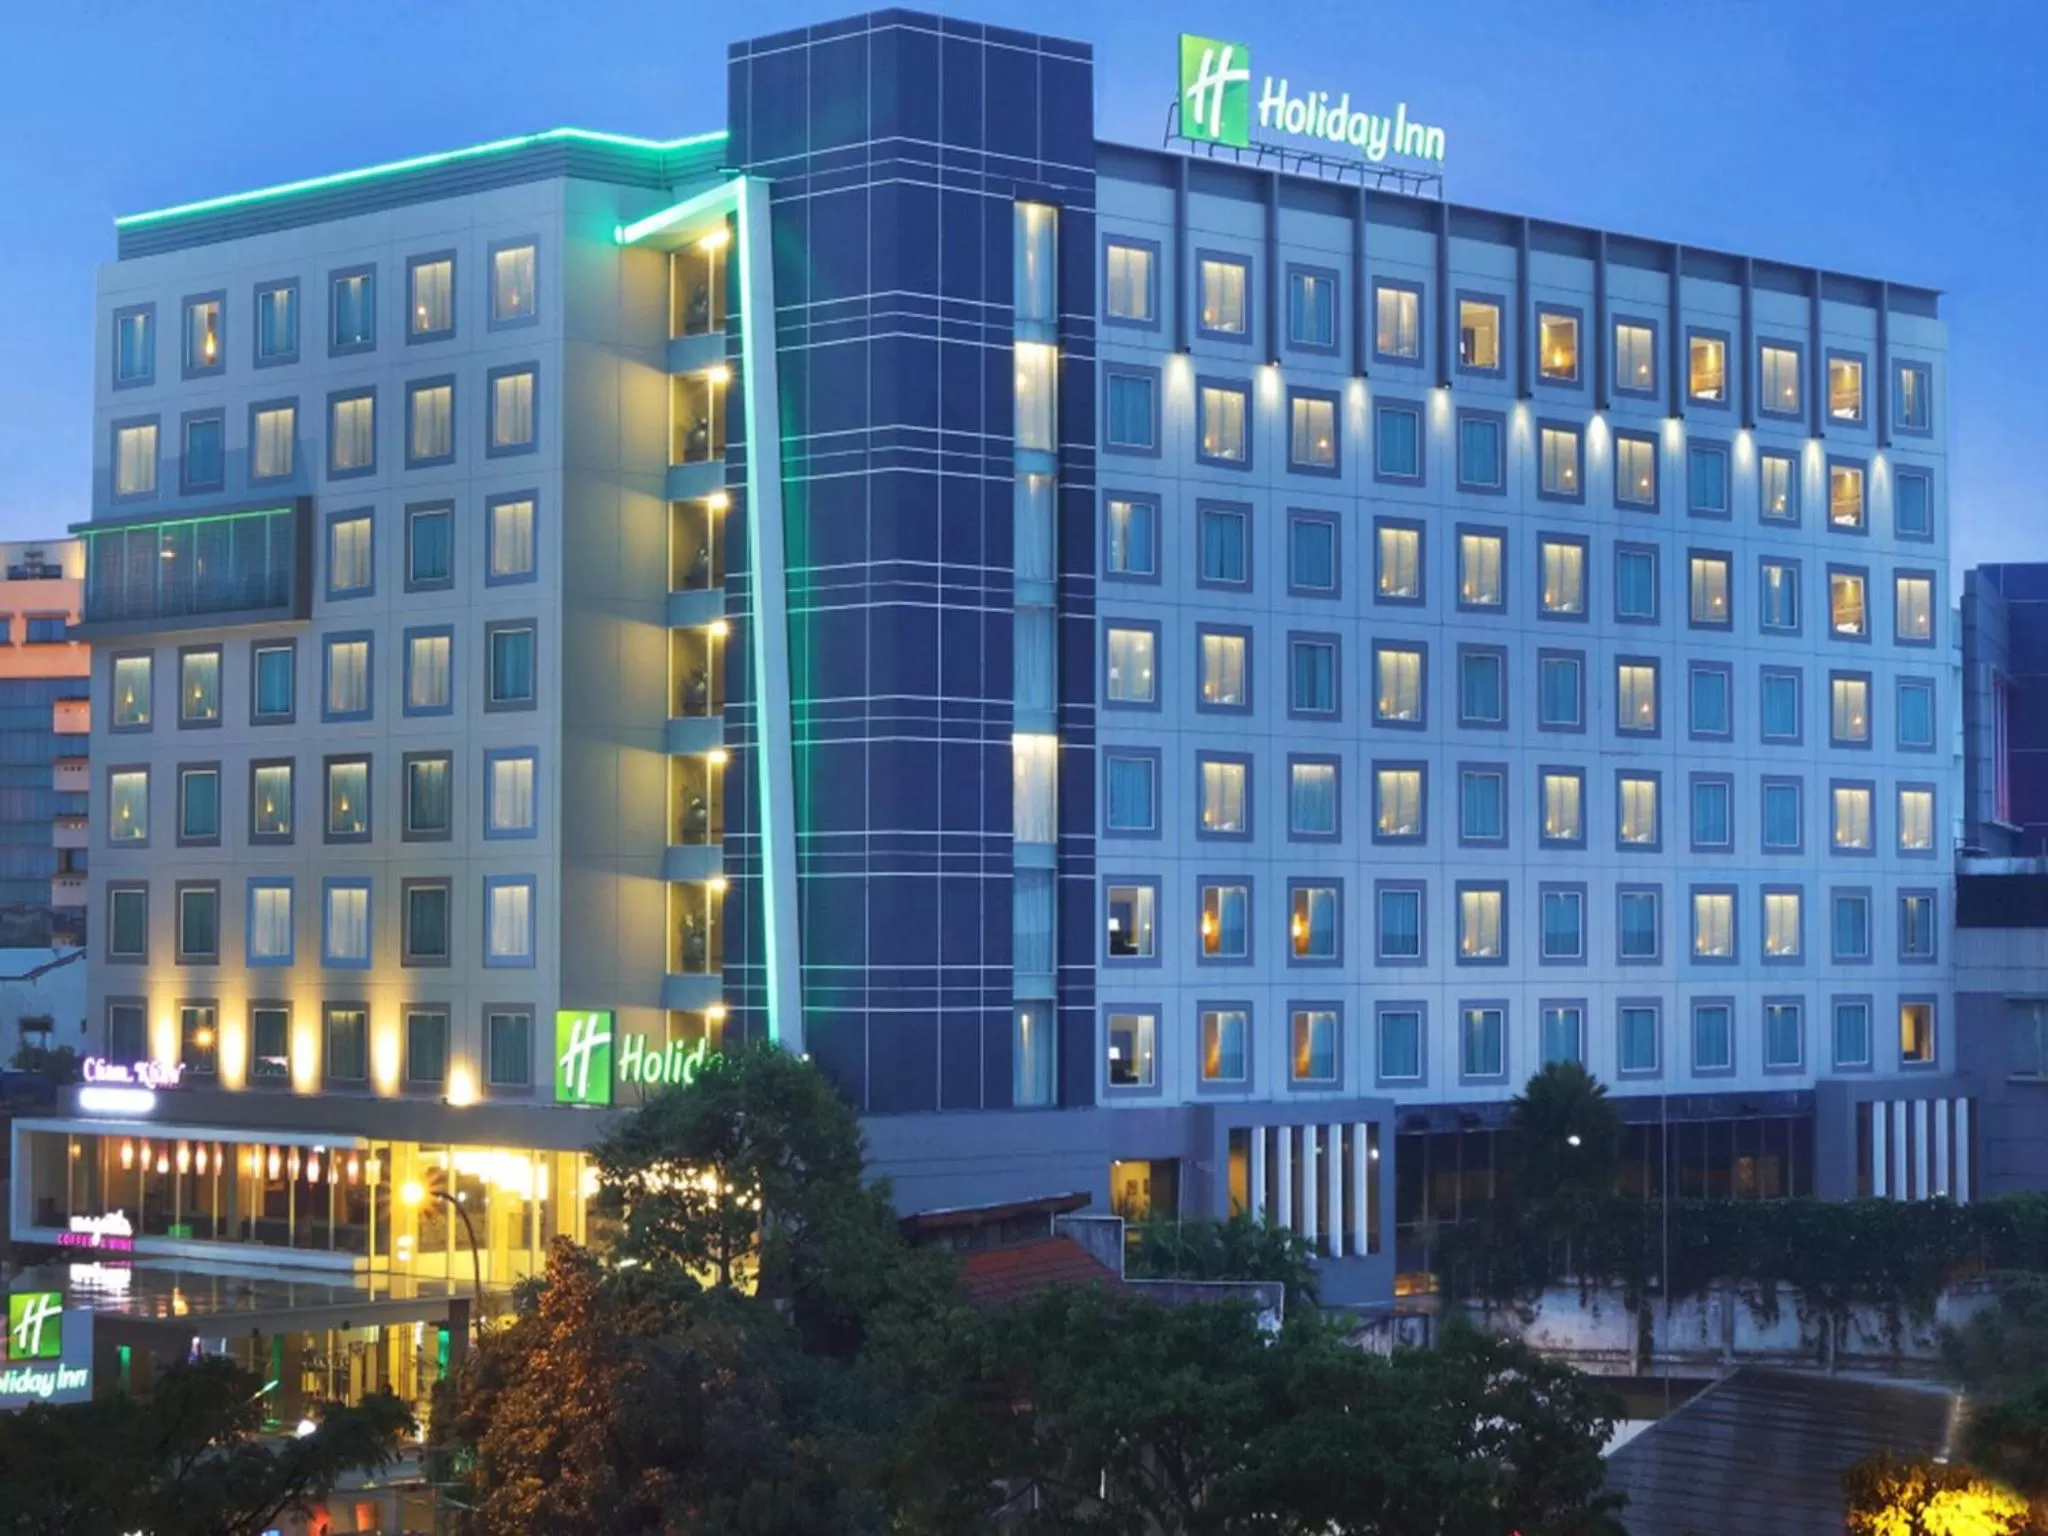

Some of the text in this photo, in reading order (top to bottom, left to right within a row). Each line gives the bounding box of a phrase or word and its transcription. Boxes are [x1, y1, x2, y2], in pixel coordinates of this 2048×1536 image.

[1258, 76, 1389, 161] Holiday
[1394, 102, 1445, 160] Inn
[57, 1363, 88, 1390] Inn
